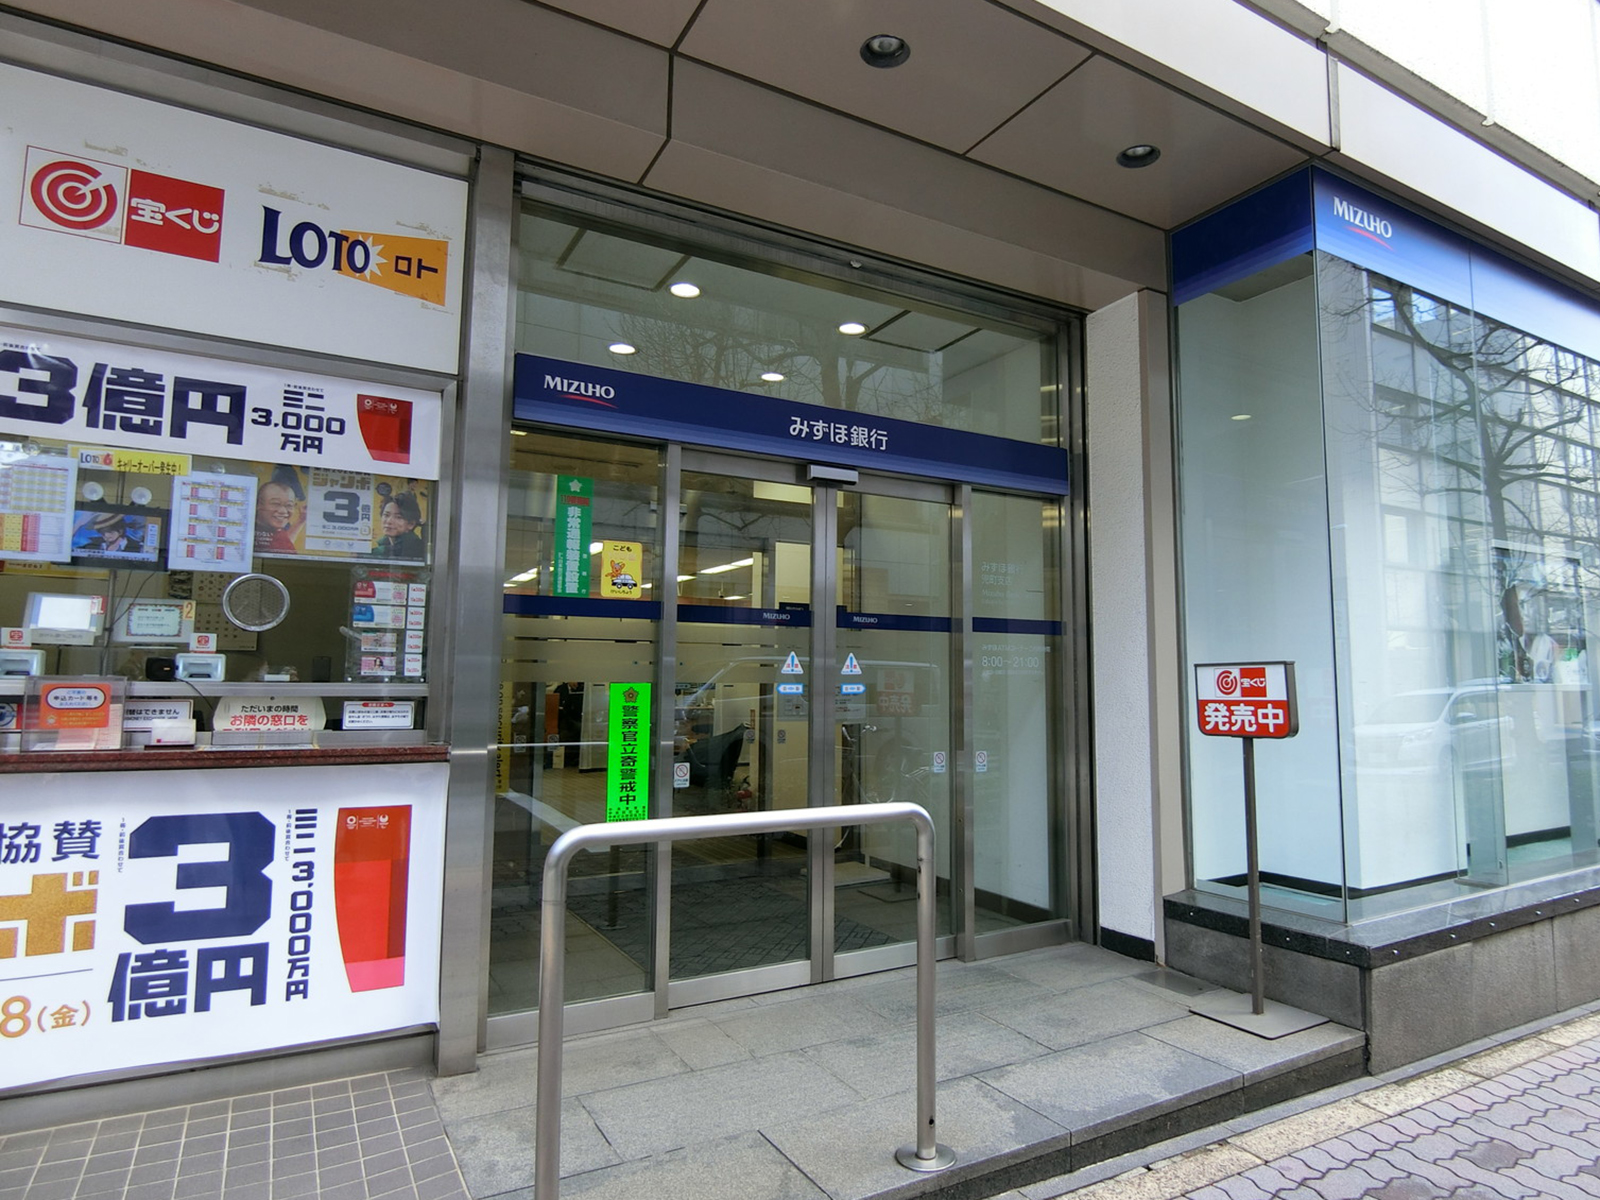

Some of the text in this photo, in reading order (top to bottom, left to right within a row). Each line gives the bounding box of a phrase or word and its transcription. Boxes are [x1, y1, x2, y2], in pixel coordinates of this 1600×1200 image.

[130, 197, 220, 234] 宝くじ
[1333, 196, 1392, 239] MIZUHO
[258, 205, 371, 274] LOTO
[394, 254, 439, 279] ロト
[0, 350, 248, 446] 3億円
[283, 389, 325, 412] ミニ
[544, 374, 616, 401] MIZUHO
[251, 406, 346, 436] 3,000
[789, 415, 889, 451] みずほ銀行
[280, 433, 323, 455] 万円
[312, 472, 371, 491] ジャンボ
[322, 490, 361, 525] 3
[360, 503, 371, 522] 億円
[612, 544, 633, 553] こども
[184, 601, 193, 619] 2
[762, 612, 791, 620] MIZUHO
[852, 615, 879, 624] MIZUHO
[1240, 676, 1266, 688] 宝くじ
[230, 714, 308, 726] お隣の窓口を
[241, 704, 299, 713] ただいまの時間
[1204, 702, 1285, 733] 発売中
[619, 705, 639, 806] 警察官立寄警戒中
[0, 820, 102, 864] 協賛
[124, 811, 277, 945] 3
[107, 941, 271, 1022] 億円
